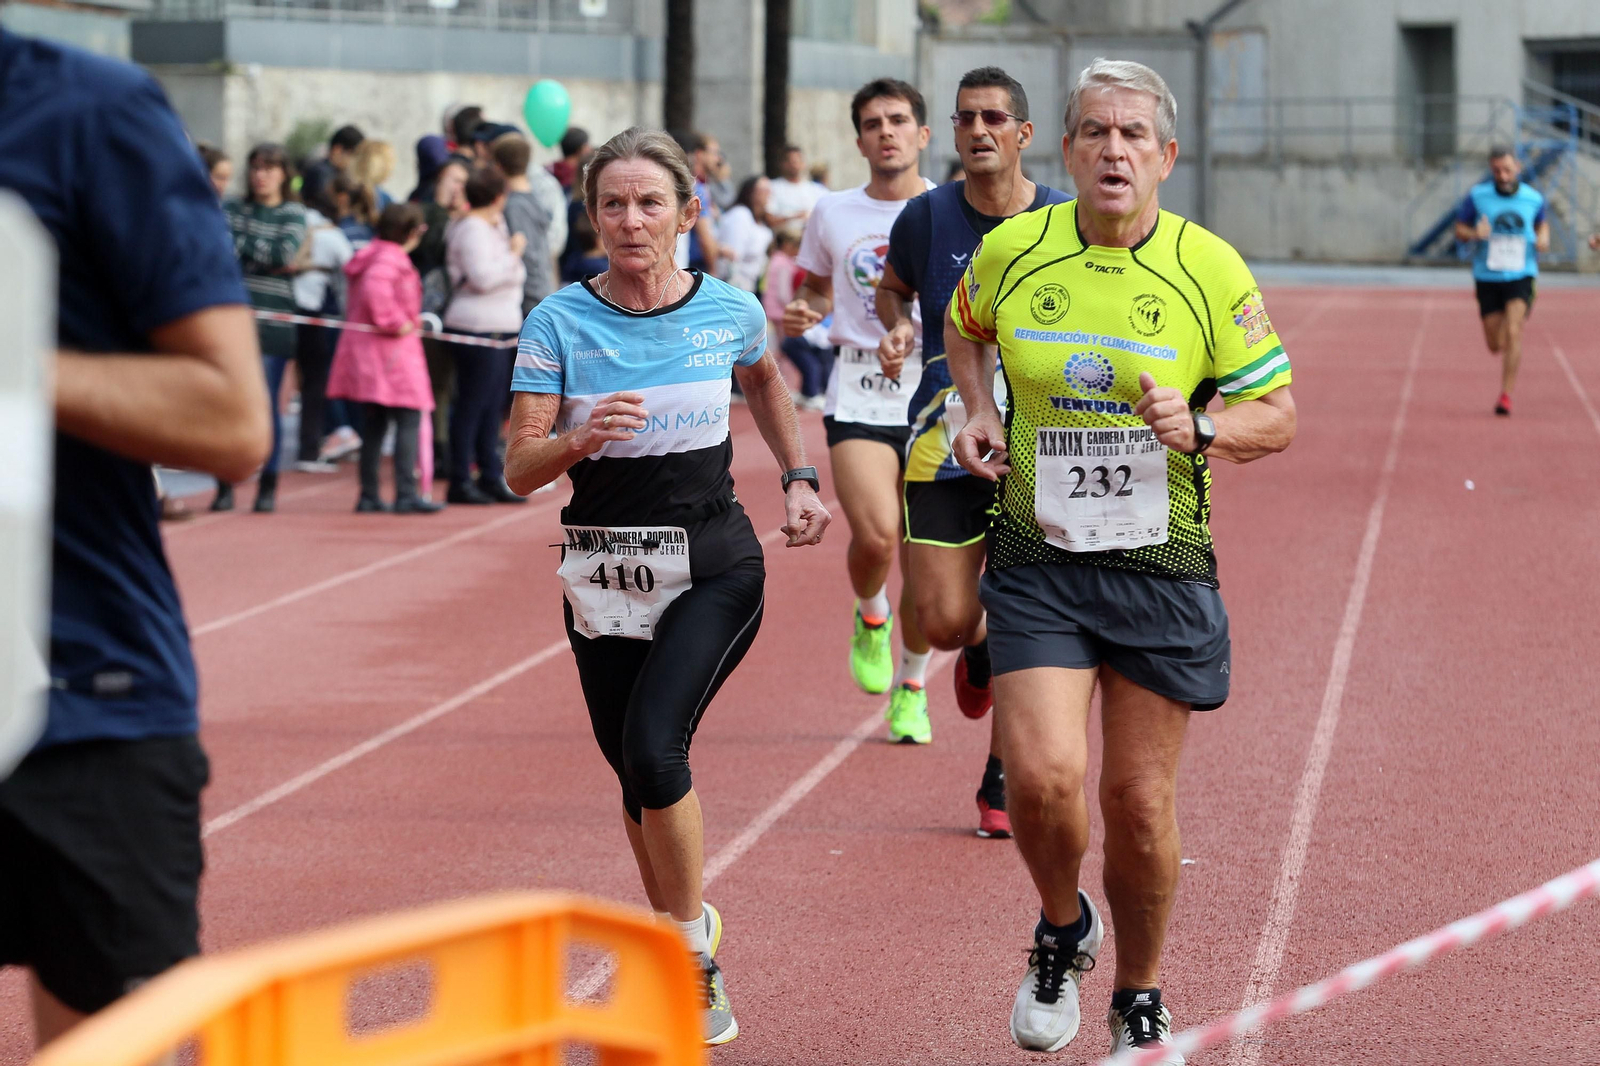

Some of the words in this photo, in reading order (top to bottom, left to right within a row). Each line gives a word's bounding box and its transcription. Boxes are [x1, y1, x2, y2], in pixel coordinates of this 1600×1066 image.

[1094, 264, 1126, 275] TACTIC
[1014, 328, 1089, 343] REFRIGERACIÓN
[1091, 334, 1100, 345] Y
[1100, 336, 1177, 360] CLIMATIZACIÓN
[572, 348, 620, 360] FOURFACTORS
[684, 352, 732, 368] JEREZ
[1049, 396, 1133, 415] VENTURA
[676, 403, 729, 430] MÁST
[1040, 430, 1084, 456] XXXIX
[1087, 430, 1125, 444] CARRERA
[1087, 445, 1120, 457] CIUDAD
[1125, 444, 1135, 455] DE
[1068, 464, 1133, 498] 232
[647, 530, 685, 544] POPULAR
[659, 545, 686, 556] JEREZ
[589, 562, 655, 593] 410
[1043, 934, 1057, 943] NIKE
[1135, 992, 1151, 1001] NIKE
